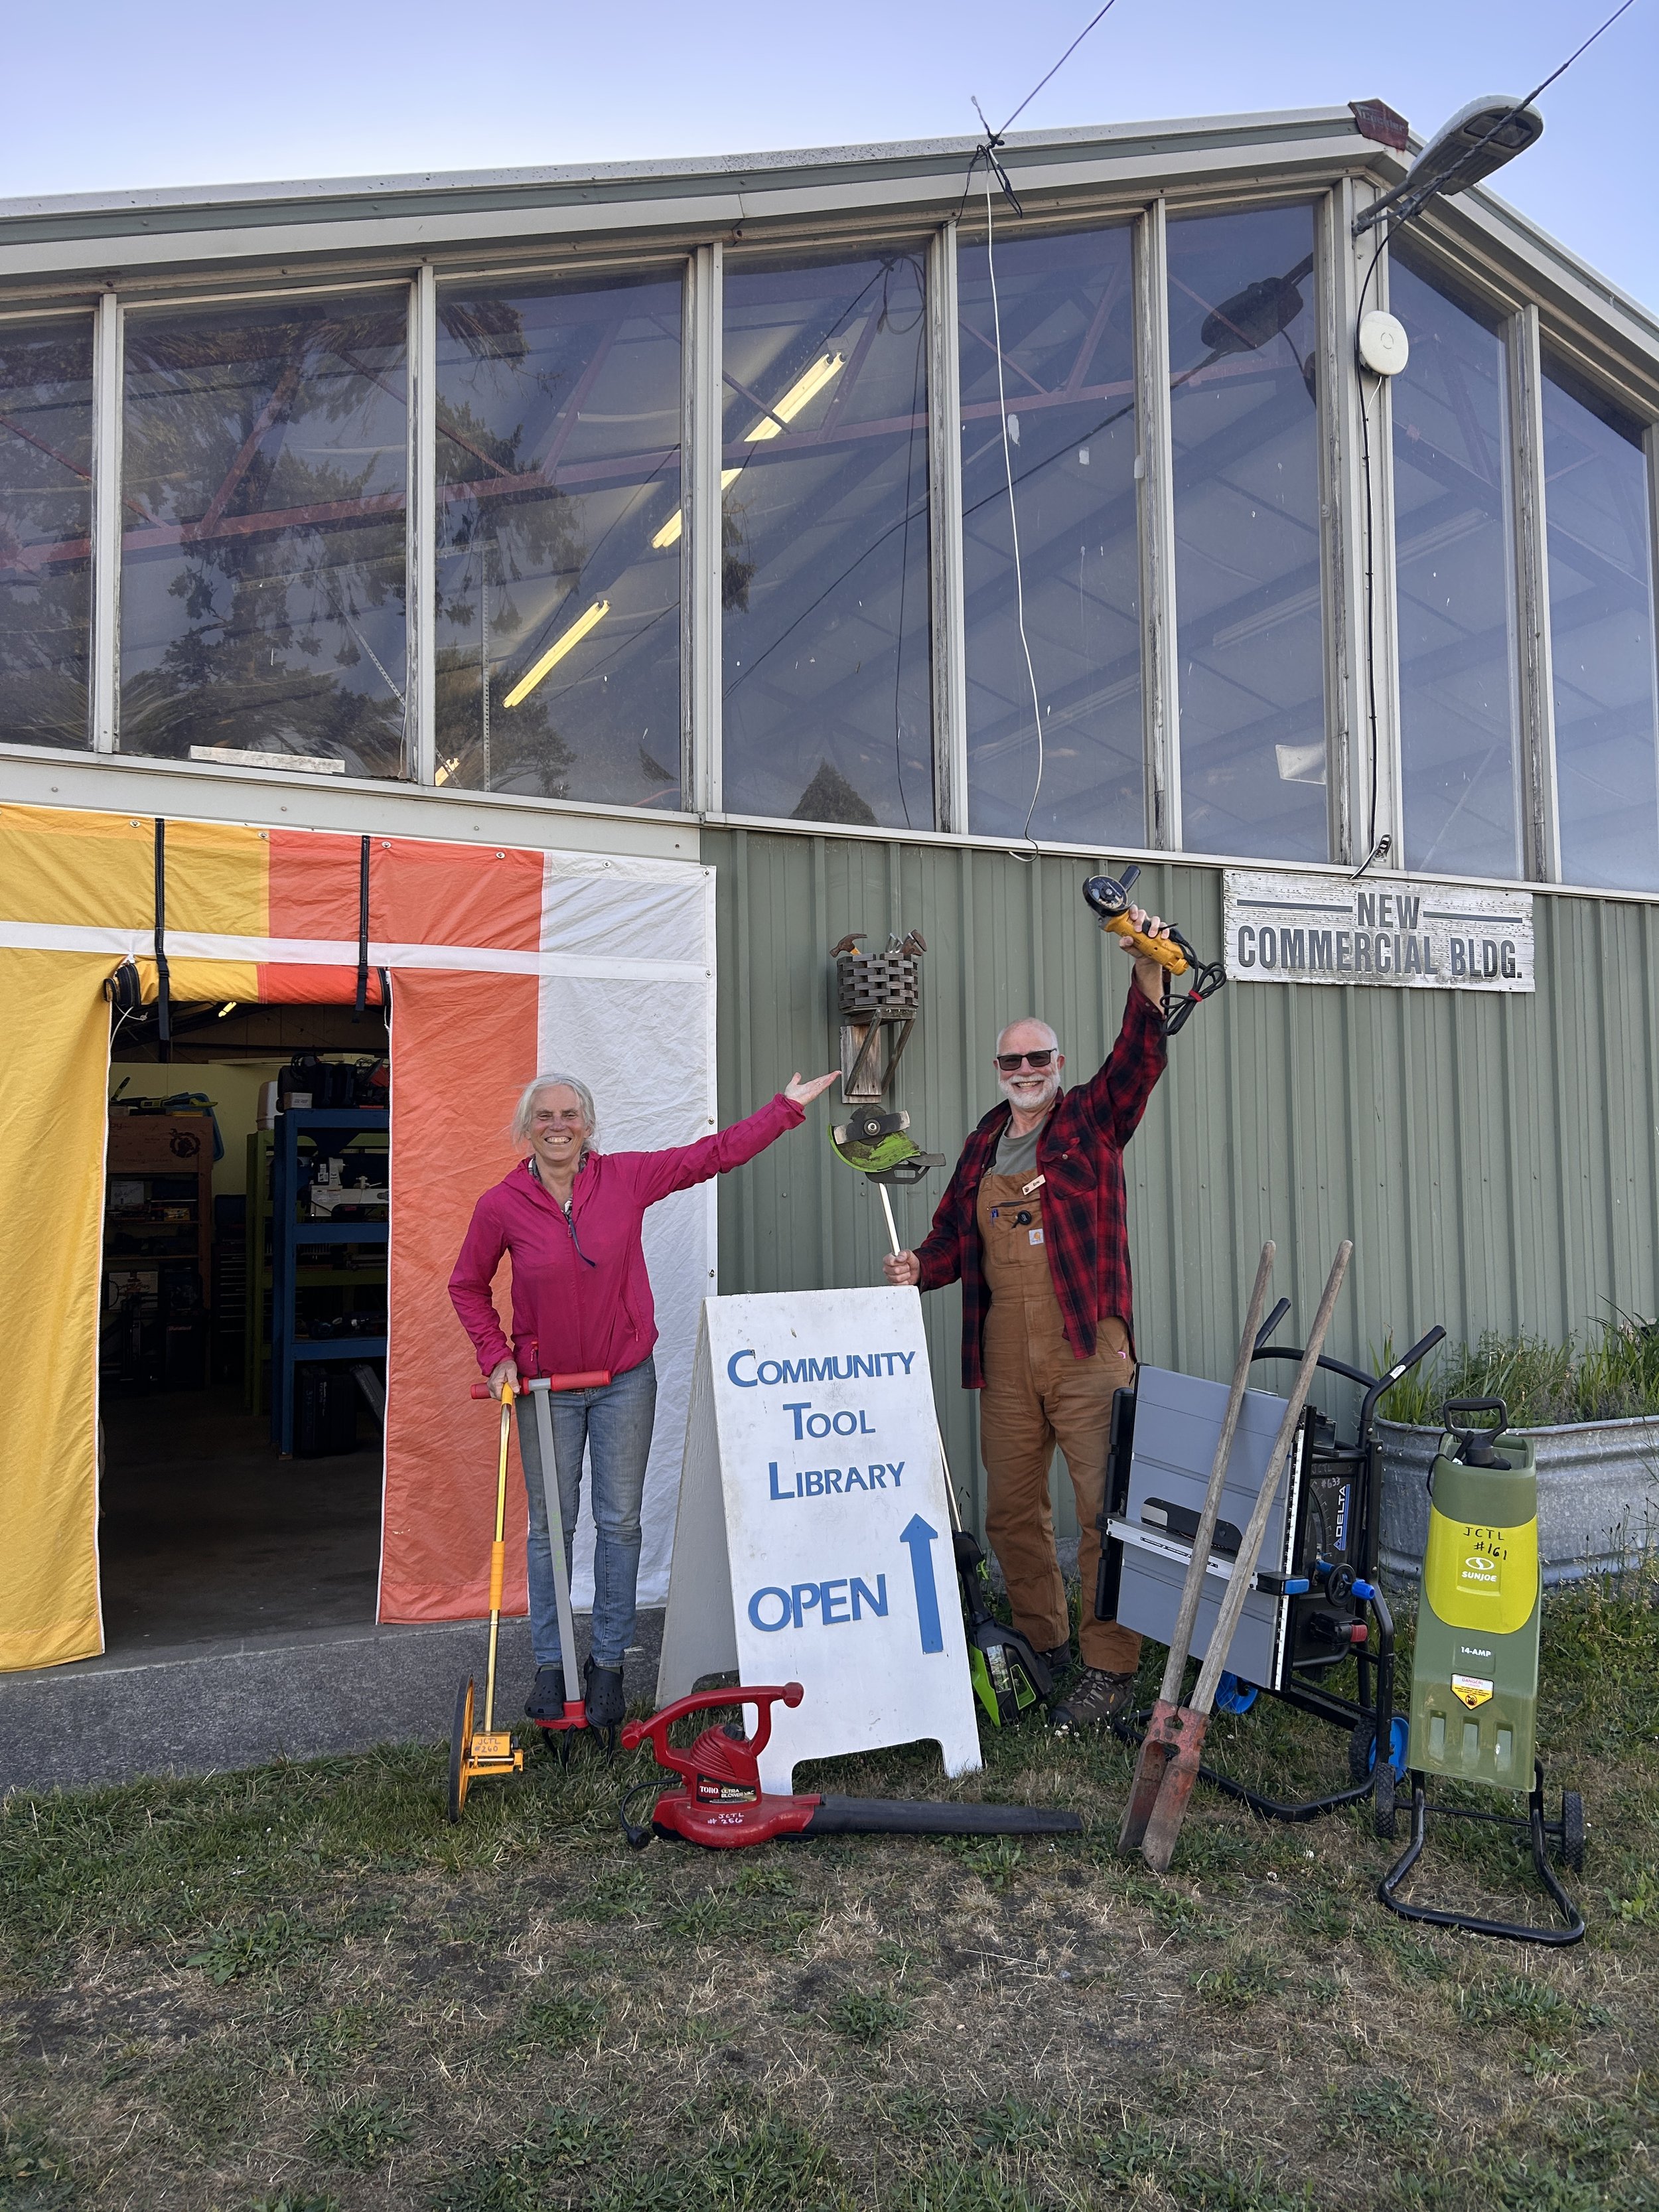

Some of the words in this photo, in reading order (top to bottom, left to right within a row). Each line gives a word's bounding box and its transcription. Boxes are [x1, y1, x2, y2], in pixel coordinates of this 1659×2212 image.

[1357, 892, 1420, 929] NEW
[1237, 925, 1438, 975] COMMERCIAL
[1450, 938, 1523, 979] BLDG.
[727, 1349, 916, 1387] COMMUNITY
[782, 1402, 876, 1440] TOOL
[768, 1461, 905, 1501] LIBRARY
[1321, 1477, 1340, 1489] #633
[1335, 1485, 1346, 1537] DELTA
[1463, 1526, 1504, 1540] JCTL
[1473, 1541, 1507, 1560] #161
[1461, 1570, 1497, 1582] SUNJOE
[747, 1573, 889, 1632] OPEN
[1461, 1646, 1491, 1657] 14-AMP
[699, 1785, 719, 1794] TORO
